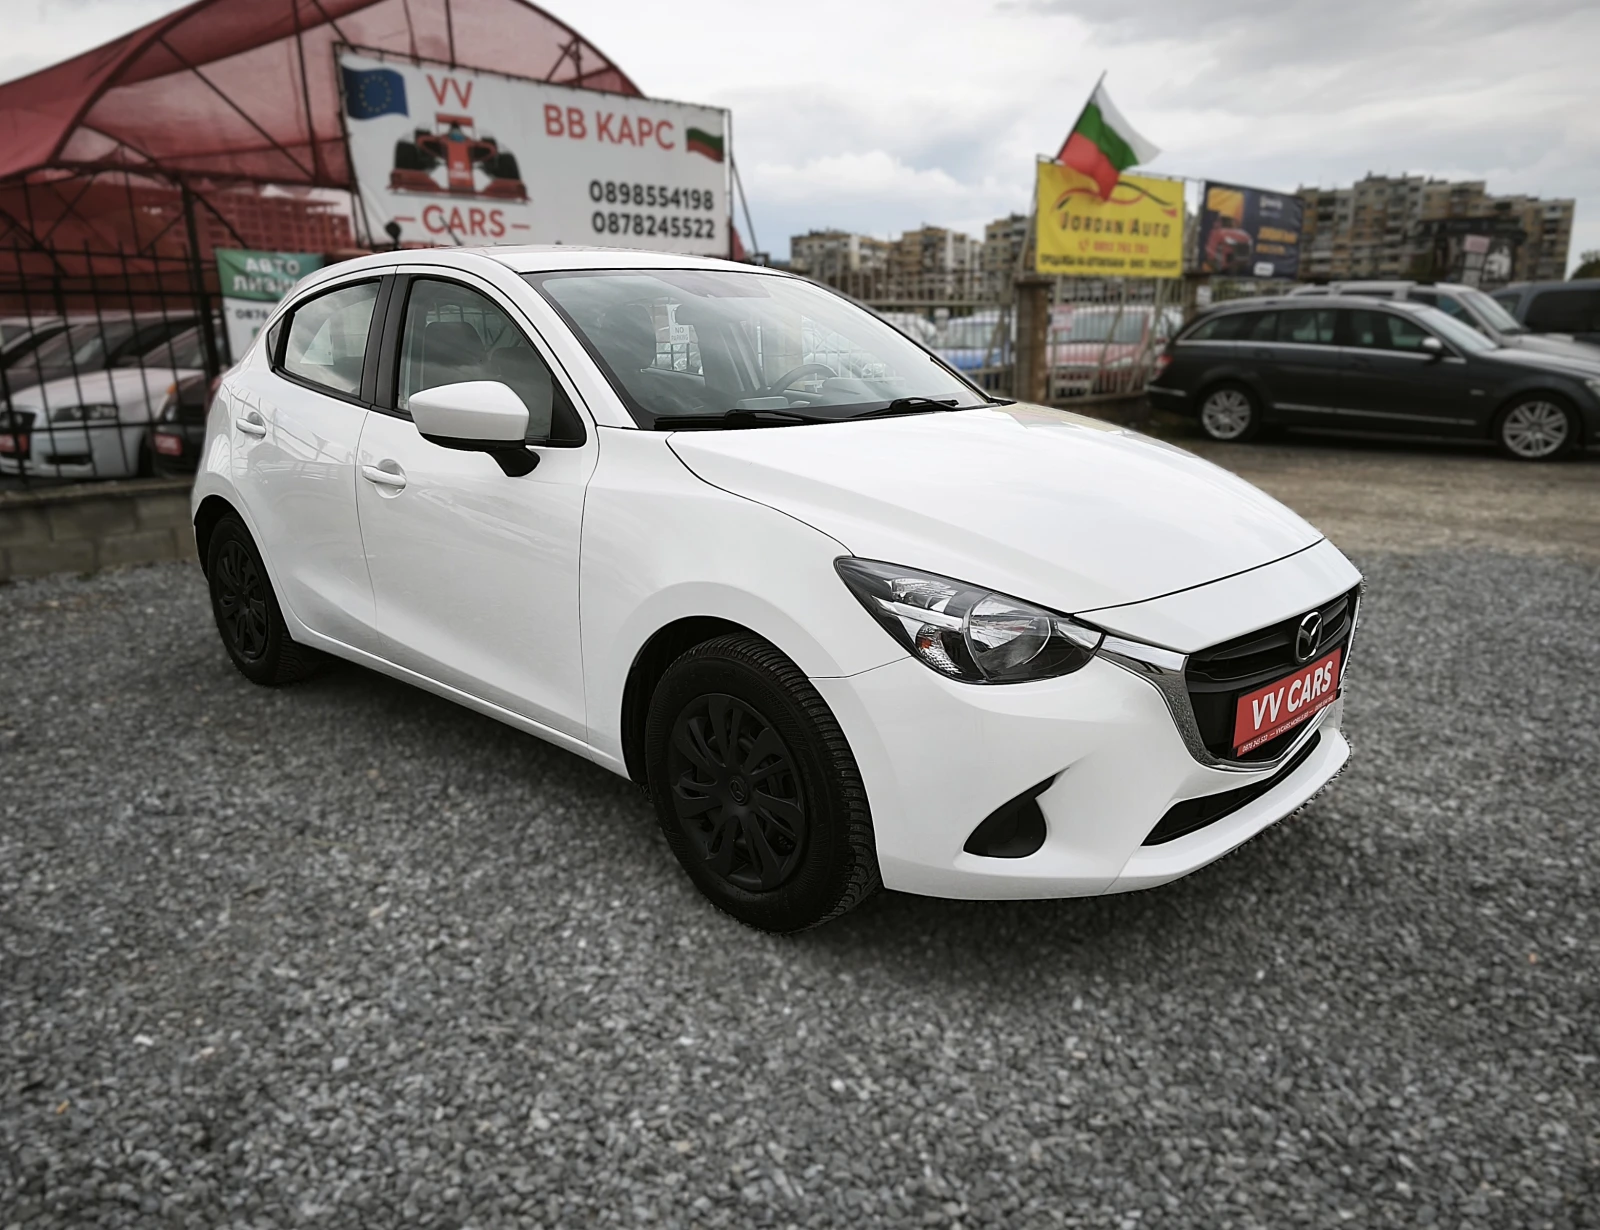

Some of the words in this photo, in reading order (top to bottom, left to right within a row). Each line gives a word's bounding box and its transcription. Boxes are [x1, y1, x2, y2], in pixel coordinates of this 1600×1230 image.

[426, 75, 474, 108] VV
[544, 104, 587, 139] ВВ
[596, 111, 676, 150] КАРС
[589, 179, 714, 211] 0898554198
[422, 205, 506, 238] CARS
[592, 210, 715, 240] 0878245522
[246, 257, 299, 275] АВТО
[233, 274, 297, 292] ЛИЗИ
[1252, 687, 1285, 730] VV
[1287, 660, 1333, 713] CARS
